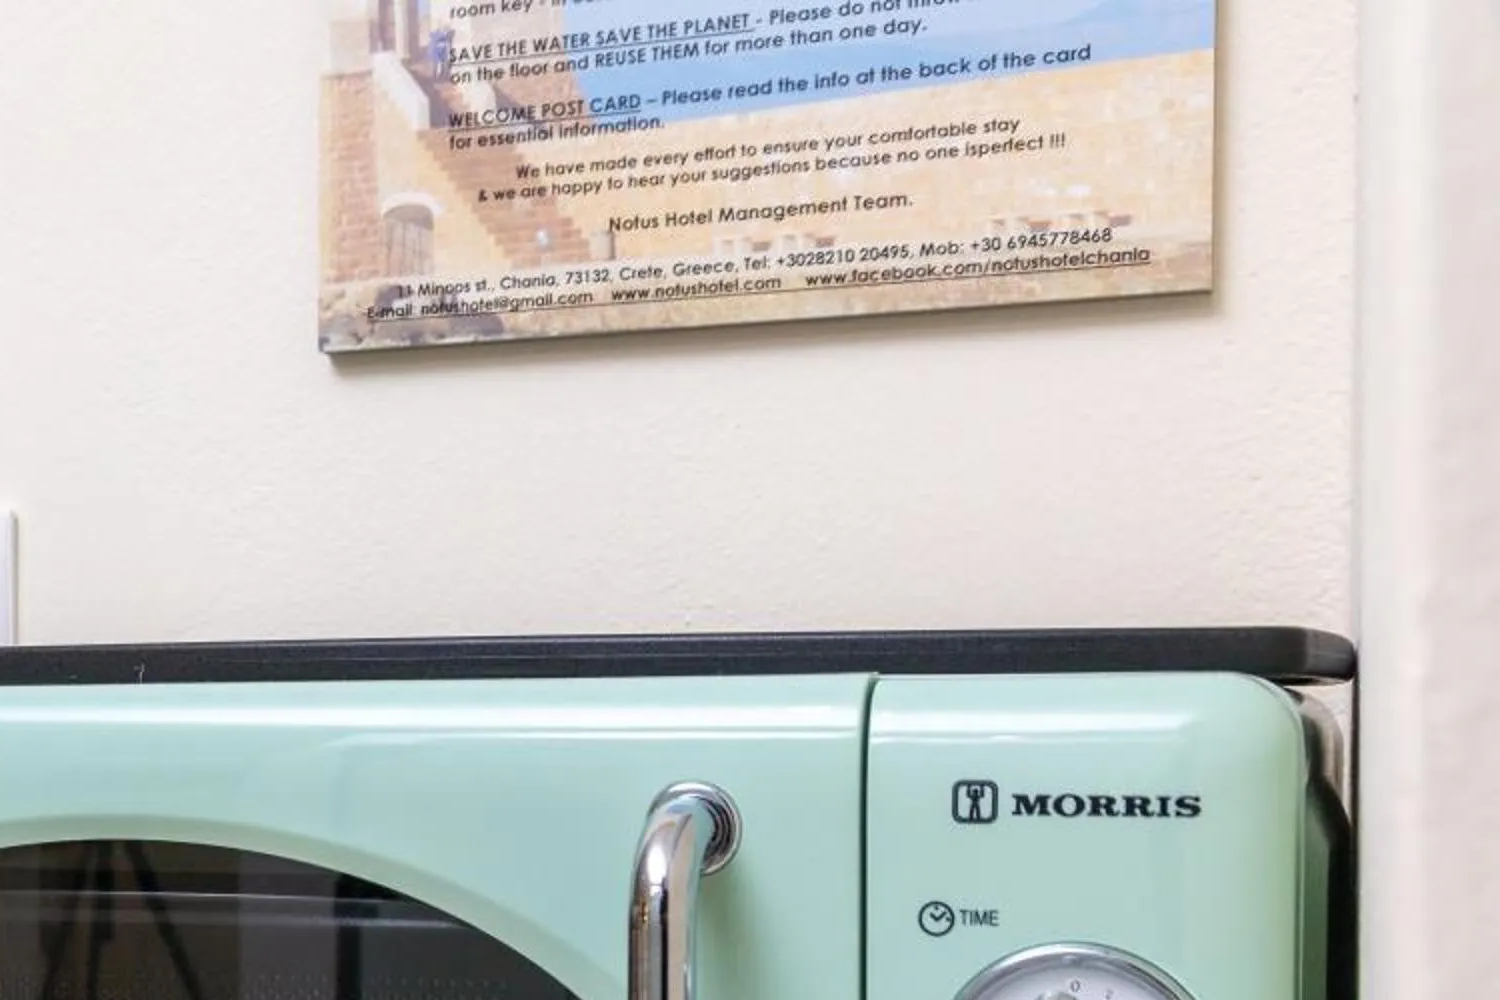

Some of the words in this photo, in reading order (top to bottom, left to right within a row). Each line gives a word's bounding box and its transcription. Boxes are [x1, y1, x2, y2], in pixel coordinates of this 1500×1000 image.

[450, 2, 495, 19] room
[450, 43, 493, 64] SAVE
[499, 40, 527, 56] THE
[533, 33, 589, 52] WATER
[595, 26, 641, 46] SAVE
[649, 21, 677, 39] THE
[684, 13, 749, 35] PLANET
[769, 5, 831, 26] Please
[838, 0, 864, 17] do
[451, 70, 471, 85] on
[477, 64, 505, 82] the
[510, 59, 549, 78] floor
[554, 55, 589, 73] and
[595, 48, 646, 68] REUSE
[652, 42, 699, 62] THEM
[705, 39, 729, 56] for
[735, 34, 785, 52] more
[790, 27, 833, 46] than
[839, 24, 877, 40] one
[883, 17, 928, 37] day.
[449, 106, 536, 129] WELCOME
[542, 99, 584, 119] POST
[589, 93, 641, 114] CARD
[661, 87, 722, 106] Please
[728, 79, 772, 100] read
[778, 76, 809, 94] the
[815, 71, 850, 90] info
[856, 68, 875, 86] at
[880, 64, 912, 82] the
[919, 57, 971, 79] back
[978, 54, 997, 72] of
[1003, 51, 1036, 69] the
[1043, 44, 1092, 65] card
[450, 134, 473, 150] for
[478, 122, 553, 148] essential
[559, 114, 665, 138] information.
[516, 164, 540, 180] We
[545, 160, 585, 177] have
[590, 155, 637, 173] made
[643, 150, 689, 168] every
[694, 144, 736, 162] effort
[741, 143, 757, 158] to
[763, 138, 819, 156] ensure
[825, 134, 862, 151] your
[867, 121, 977, 145] comfortable
[983, 118, 1021, 135] stay
[477, 189, 488, 203] &
[493, 187, 515, 201] we
[520, 183, 548, 199] are
[552, 178, 602, 197] happy
[607, 176, 623, 192] to
[628, 172, 665, 189] hear
[671, 168, 706, 188] your
[711, 158, 810, 182] suggestions
[815, 149, 892, 171] because
[897, 148, 920, 163] no
[925, 144, 959, 161] one
[609, 215, 659, 232] Notus
[665, 208, 712, 227] Hotel
[718, 196, 847, 222] Management
[853, 193, 914, 211] Team.
[776, 249, 855, 268] +3028210
[918, 240, 965, 258] Mob:
[970, 236, 1001, 252] +30
[1006, 227, 1113, 250] 6945778468
[611, 277, 782, 301] www.notushotel.com
[1011, 793, 1203, 818] MORRIS
[959, 908, 1000, 928] TIME
